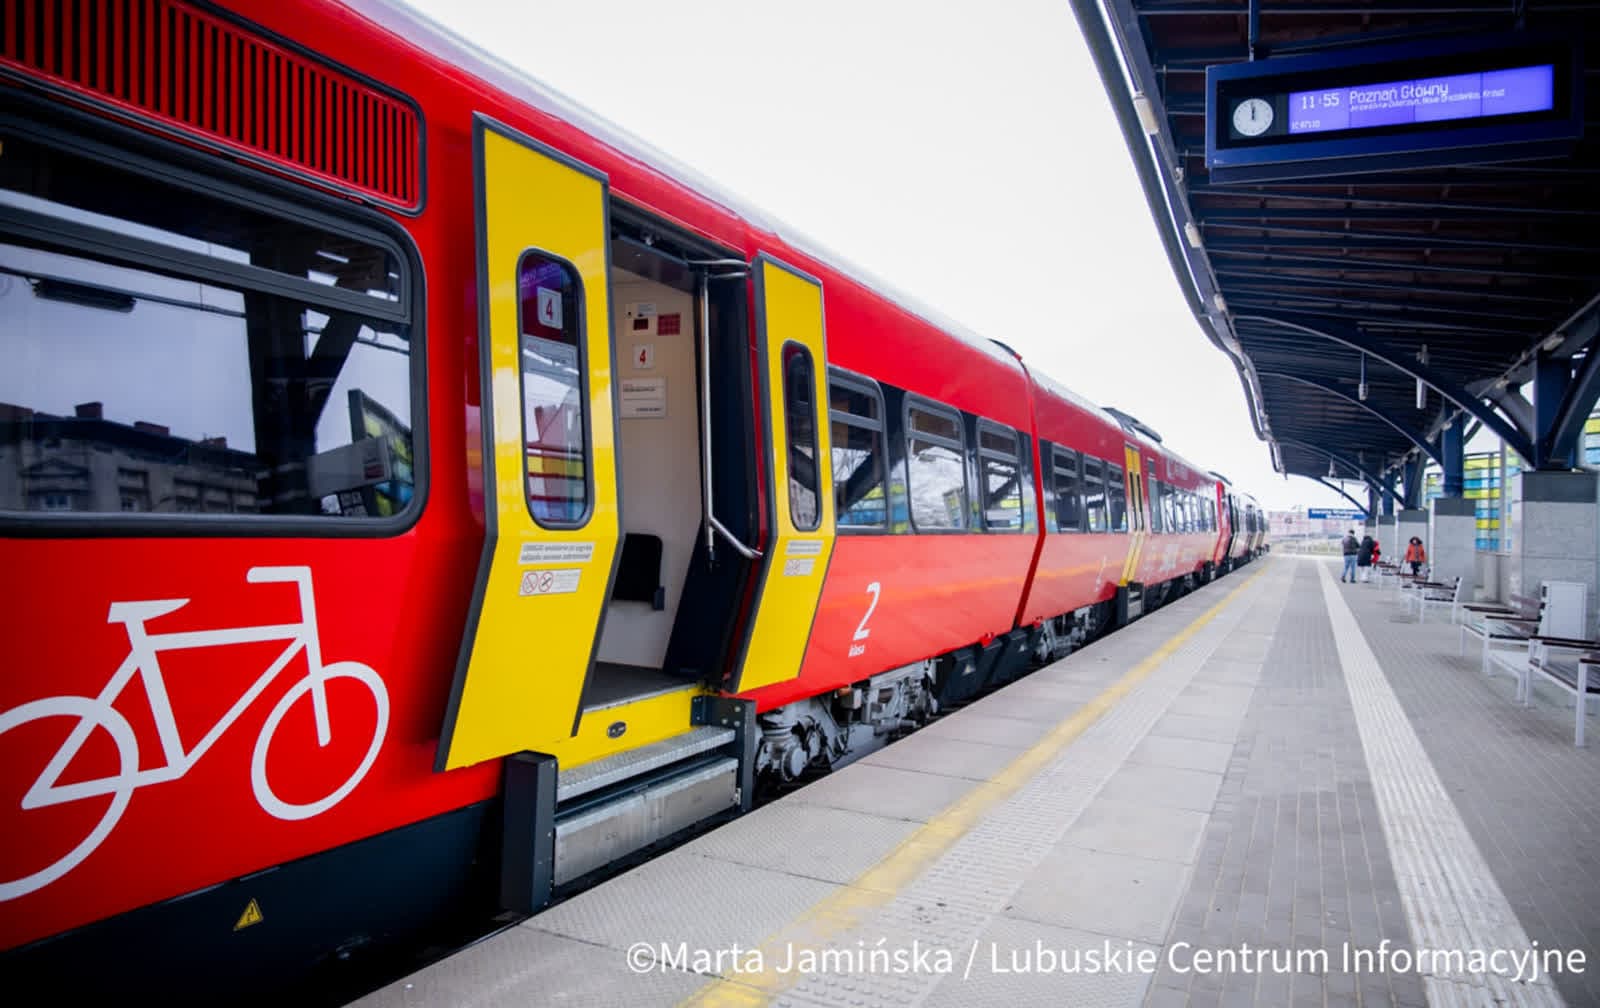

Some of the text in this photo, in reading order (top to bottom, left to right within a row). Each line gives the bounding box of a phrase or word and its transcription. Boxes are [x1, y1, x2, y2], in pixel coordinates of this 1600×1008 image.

[1350, 87, 1398, 105] Poznań
[1401, 83, 1449, 99] Główny
[545, 298, 554, 321] 4
[639, 348, 647, 364] 4
[852, 581, 881, 641] 2
